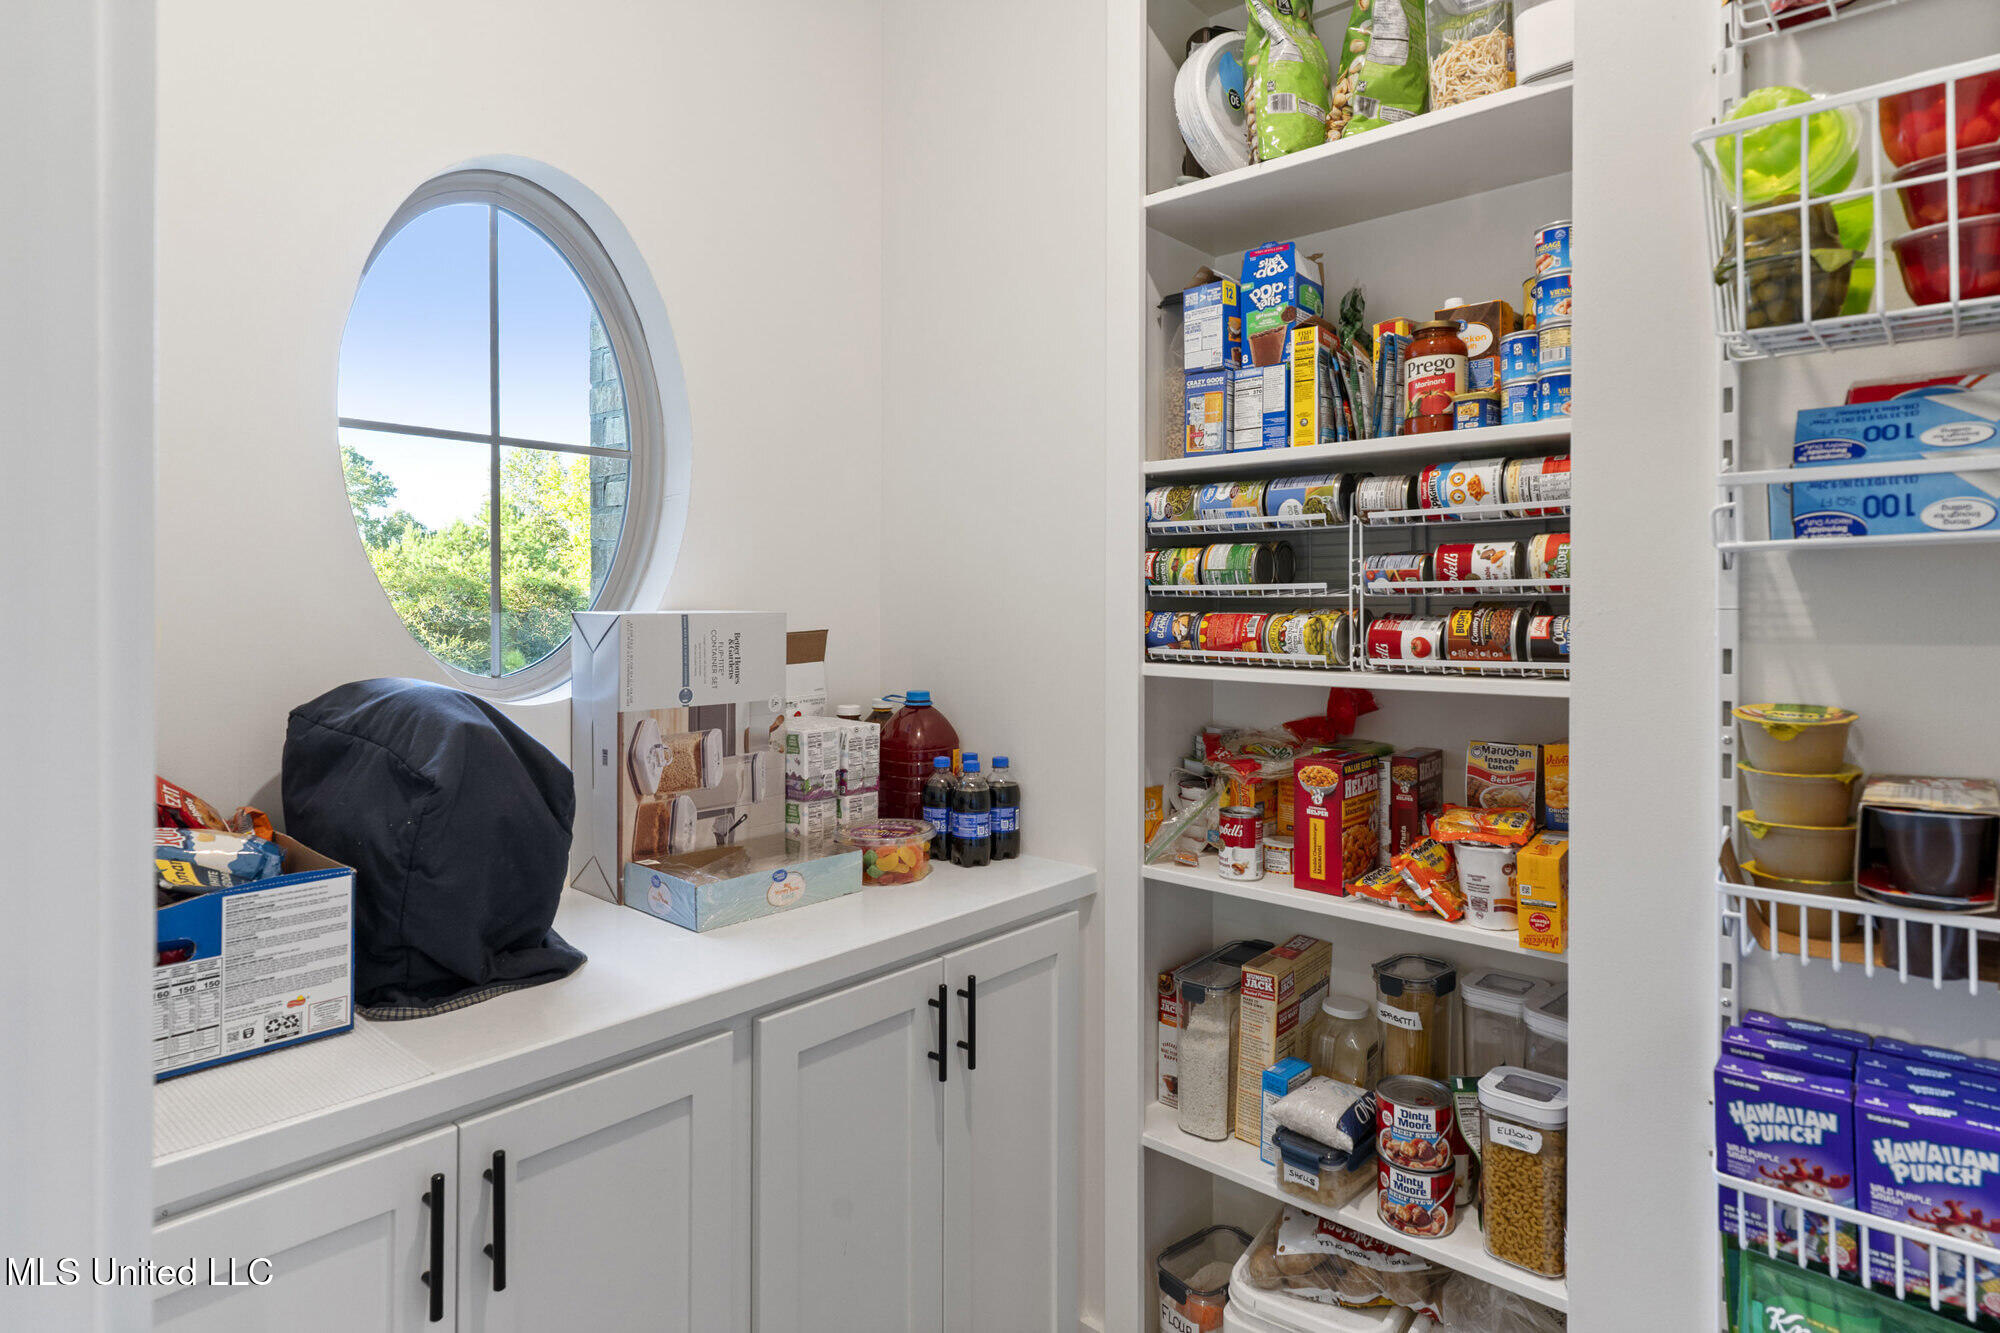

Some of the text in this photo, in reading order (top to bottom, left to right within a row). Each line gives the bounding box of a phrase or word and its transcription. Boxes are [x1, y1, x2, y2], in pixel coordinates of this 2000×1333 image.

[1226, 287, 1234, 300] 12
[1407, 357, 1456, 380] Prego
[1415, 378, 1447, 389] Marinara
[1863, 422, 1915, 443] 100
[1820, 493, 1916, 520] 100 SQ FT
[710, 629, 718, 690] CONTAINER SET
[727, 645, 736, 680] Gardens
[733, 632, 742, 686] Better Homes
[1481, 745, 1533, 759] Maruchan
[1484, 755, 1520, 766] Instant
[1487, 763, 1516, 773] Lunch
[1344, 773, 1378, 799] HELPER
[1490, 774, 1511, 784] Beef
[1306, 808, 1329, 818] HELPER
[178, 985, 195, 995] 150
[204, 979, 220, 989] 150
[1244, 979, 1275, 993] JACK
[1399, 1108, 1429, 1123] Dinty
[1727, 1099, 1839, 1134] HAWAIIAN
[1397, 1117, 1432, 1131] Moore
[1414, 1131, 1439, 1140] STEW
[1742, 1122, 1824, 1146] PUNCH
[1748, 1148, 1780, 1164] PURPLE
[1871, 1137, 1999, 1175] HAWAIIAN
[1287, 1168, 1316, 1186] SHELLS
[1395, 1172, 1424, 1188] Dinty
[1889, 1161, 1983, 1187] PUNCH
[1393, 1181, 1427, 1197] Moore
[1409, 1197, 1434, 1206] STEW
[1895, 1189, 1933, 1206] PURPLE
